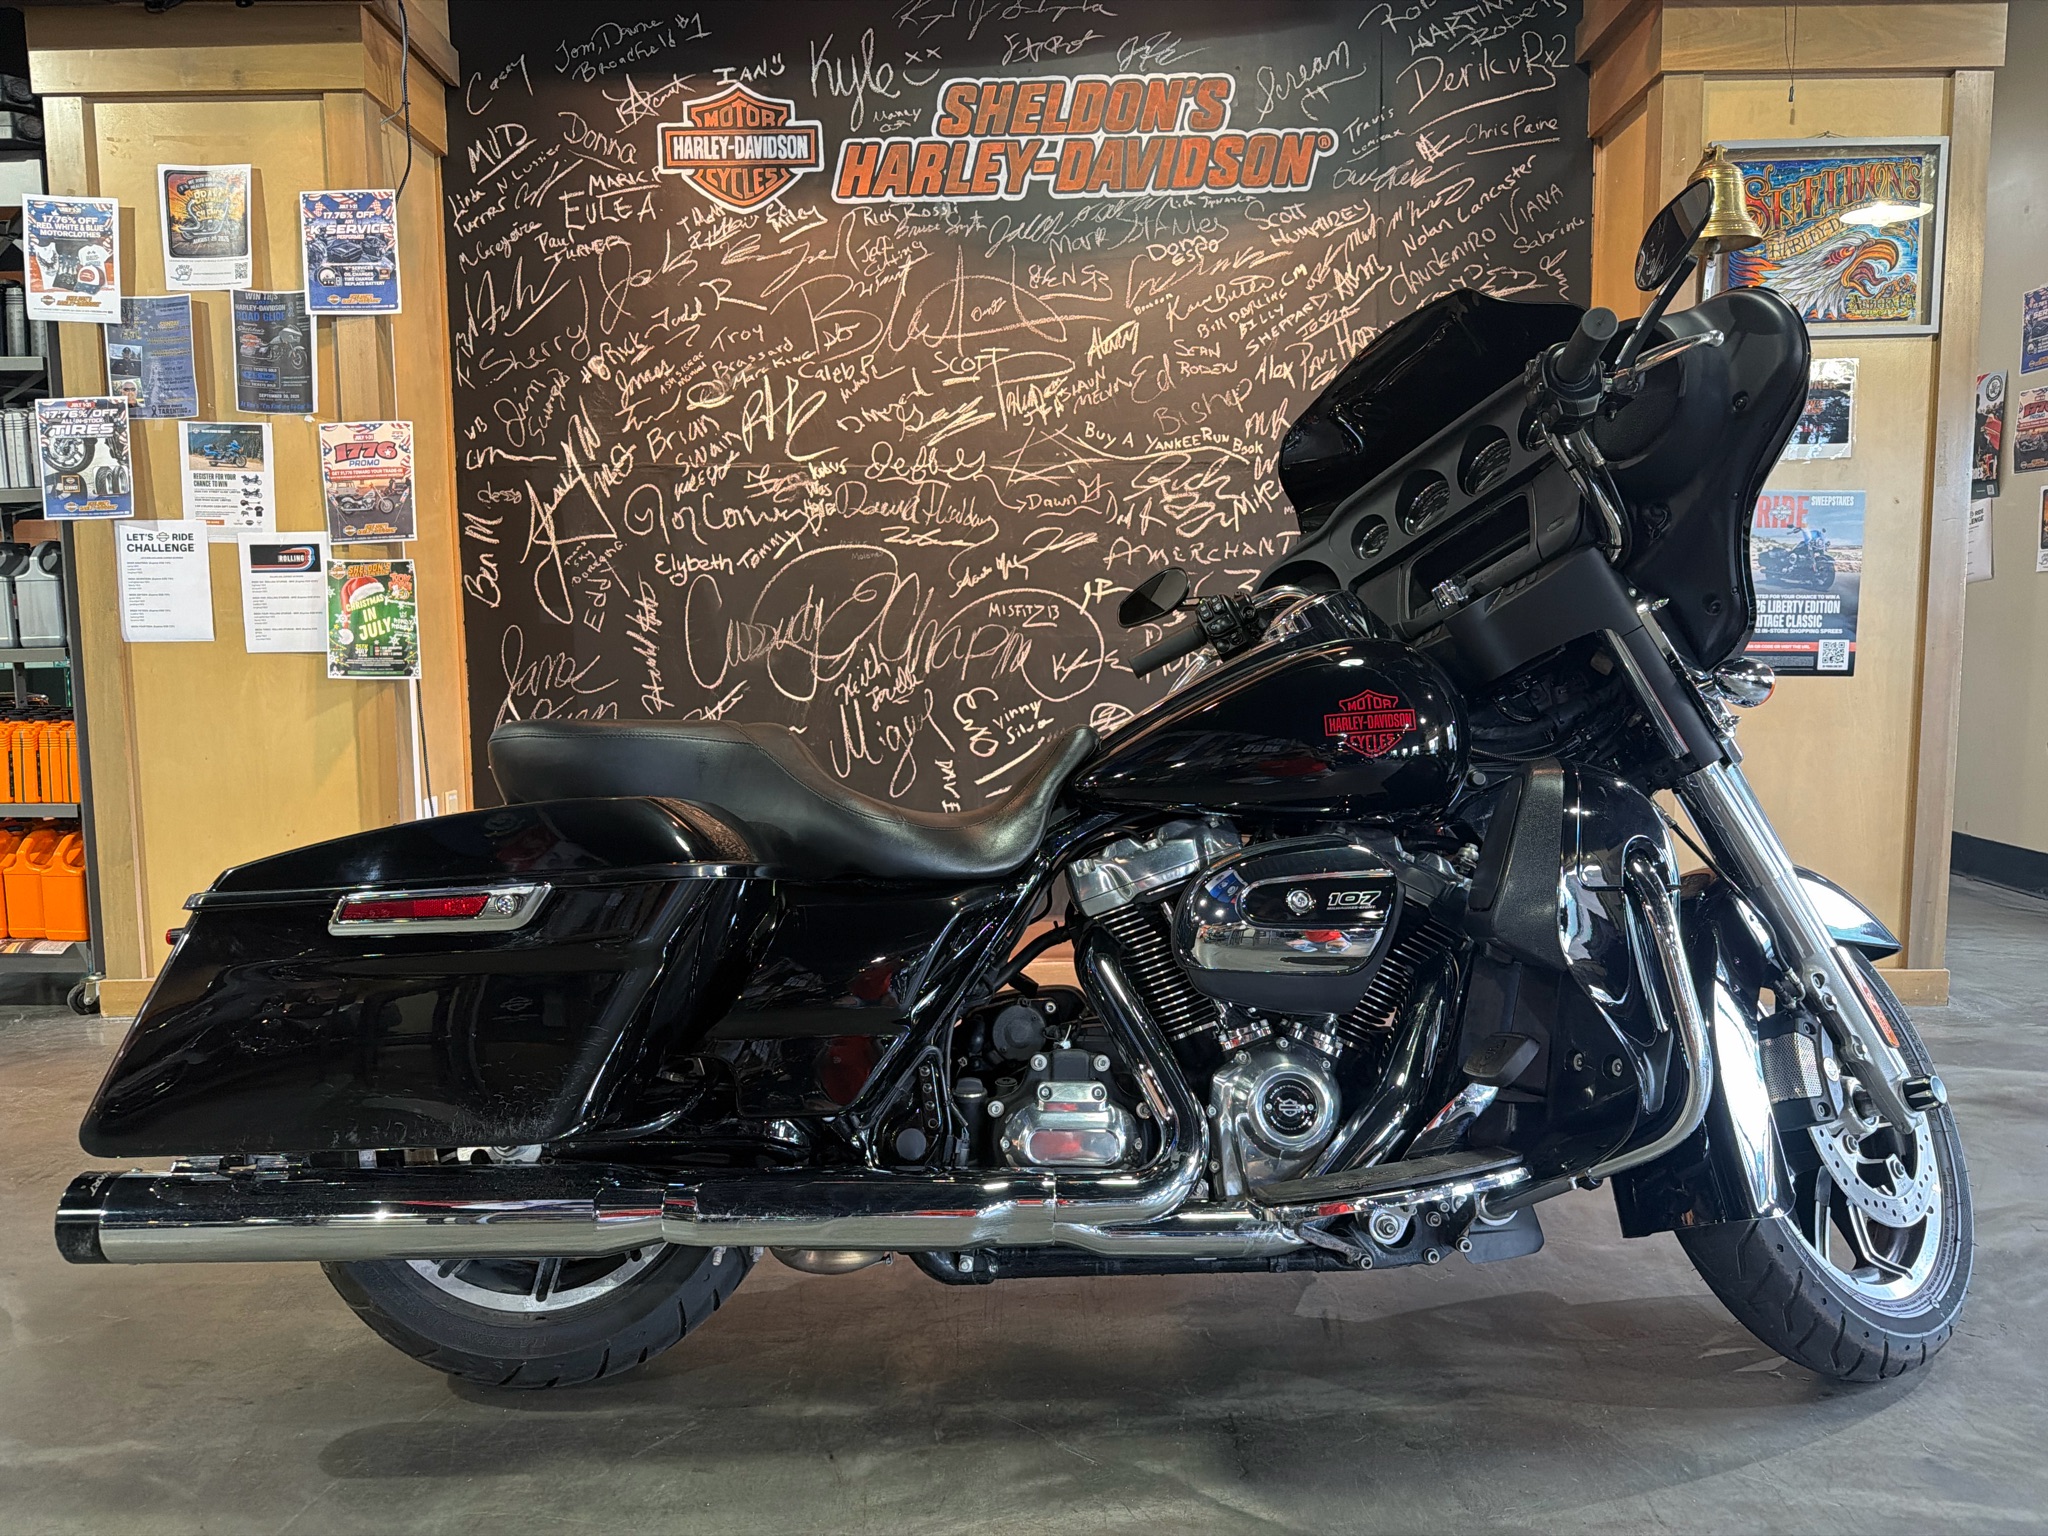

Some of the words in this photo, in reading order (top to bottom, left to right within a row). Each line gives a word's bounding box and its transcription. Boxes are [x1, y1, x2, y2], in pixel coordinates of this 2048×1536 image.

[810, 27, 901, 132] Kyle
[703, 99, 778, 128] MOTOR
[939, 79, 1229, 138] SHELDON'S
[557, 111, 638, 165] Donna
[672, 134, 809, 161] HARLEY-DAVIDSON
[705, 167, 779, 199] CYCLES
[1401, 217, 1454, 258] Nolan
[1456, 154, 1537, 224] Lancaster
[42, 215, 76, 225] 17.76%
[78, 216, 98, 225] OFF
[323, 211, 354, 220] 17.76%
[356, 211, 375, 219] OFF
[40, 229, 101, 238] MOTORCLOTHES
[54, 223, 80, 232] WHITE
[310, 226, 321, 234] K
[326, 223, 390, 234] SERVICE
[245, 292, 261, 300] WIN
[234, 304, 286, 312] HARLEY-DAVIDSON
[236, 312, 260, 321] ROAD
[710, 324, 764, 352] Troy
[797, 362, 856, 385] Caleb
[92, 409, 118, 417] OFF
[52, 423, 114, 434] TIRES
[1122, 432, 1134, 448] A
[334, 441, 398, 464] 1776
[1756, 495, 1810, 528] RIDE
[1811, 495, 1854, 506] SWEEPSTAKES
[126, 533, 154, 542] LET'S
[172, 533, 194, 542] RIDE
[126, 543, 195, 552] CHALLENGE
[345, 594, 385, 612] CHRISTMAS
[1768, 600, 1802, 614] LIBERTY
[1804, 600, 1840, 614] EDITION
[362, 606, 378, 623] IN
[1786, 614, 1822, 628] CLASSIC
[358, 616, 392, 641] JULY
[1347, 694, 1392, 711] MOTOR
[1328, 712, 1412, 732] HARLEY-DAVIDSON
[1349, 733, 1395, 753] CYCLES
[1328, 890, 1382, 906] 107
